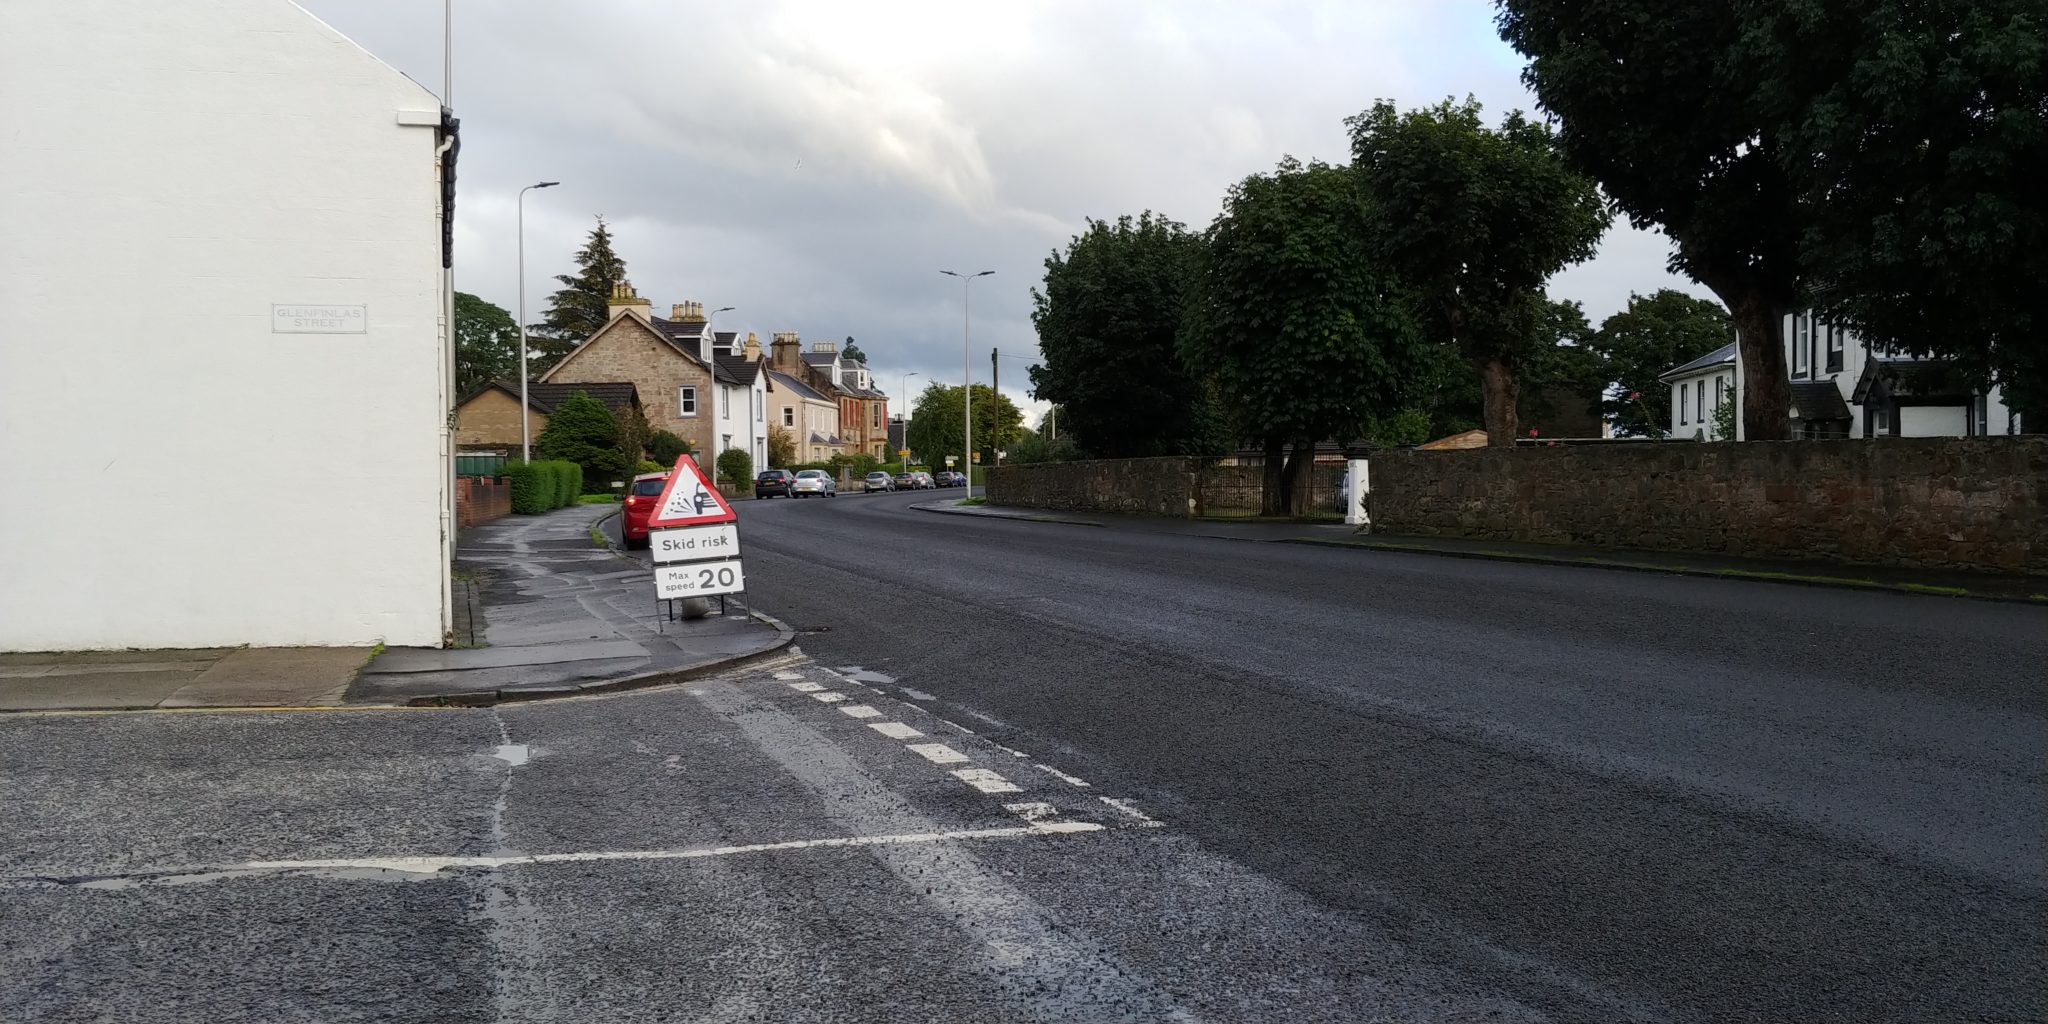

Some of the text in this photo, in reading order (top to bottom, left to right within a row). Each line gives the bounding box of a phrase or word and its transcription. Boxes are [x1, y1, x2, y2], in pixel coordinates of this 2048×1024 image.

[277, 308, 361, 318] GLENFINLAS
[294, 318, 344, 327] STREET
[662, 535, 728, 551] Skid risk
[668, 572, 689, 580] Max
[698, 567, 735, 589] 20
[665, 581, 695, 592] speed
